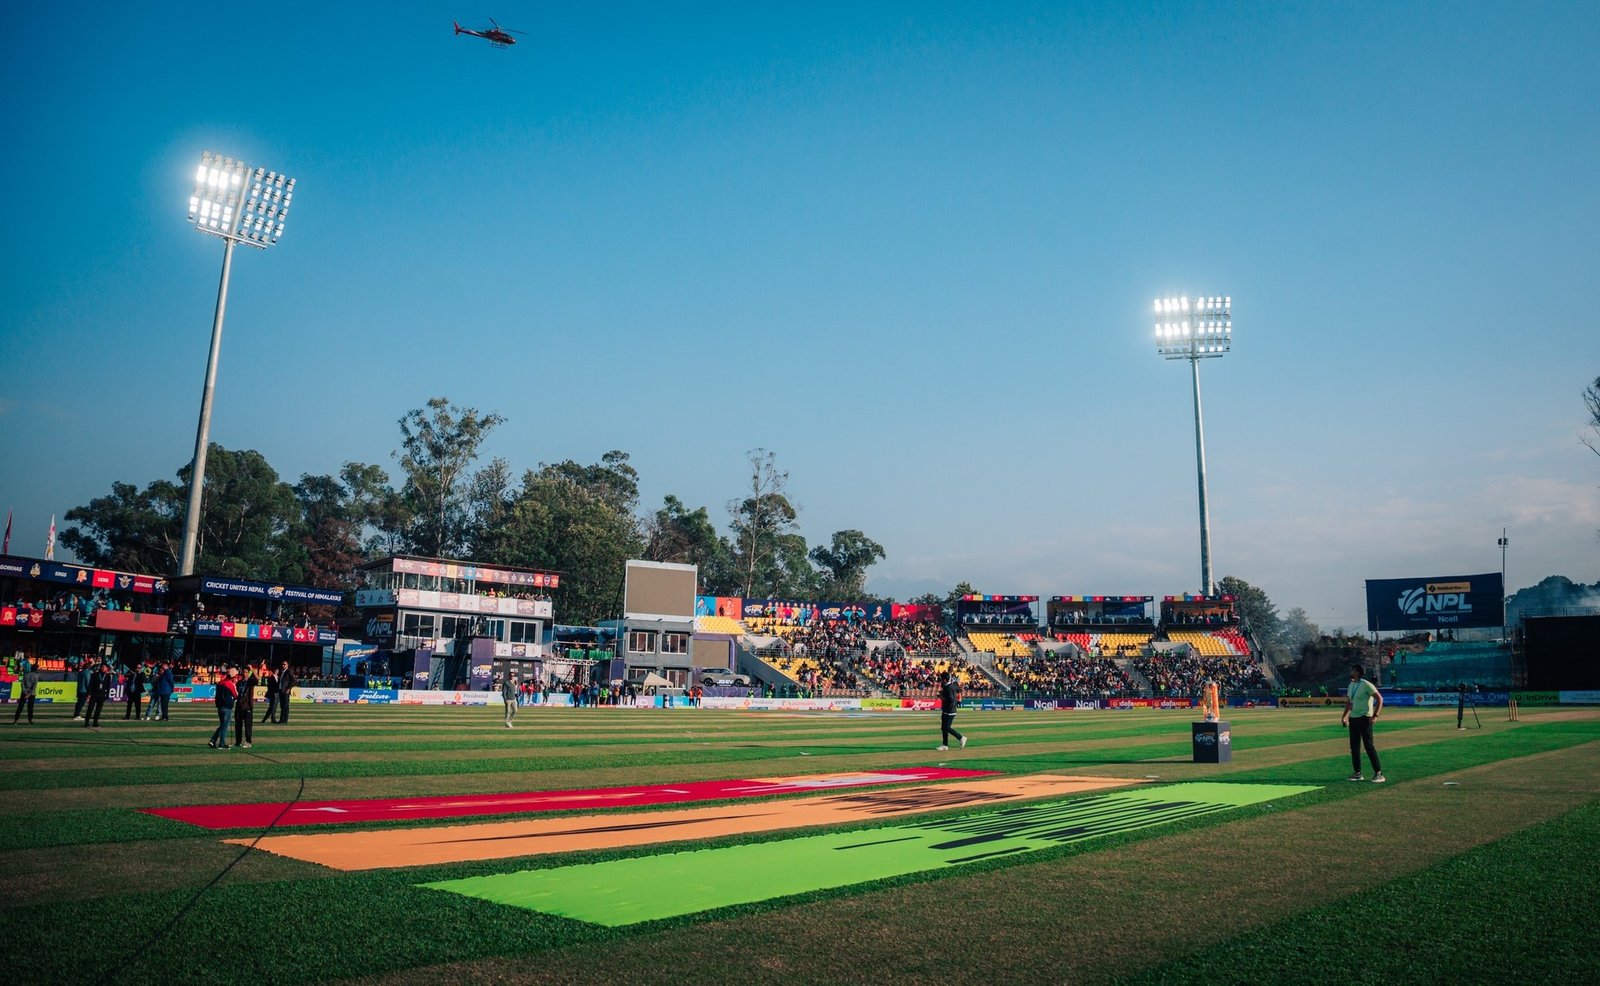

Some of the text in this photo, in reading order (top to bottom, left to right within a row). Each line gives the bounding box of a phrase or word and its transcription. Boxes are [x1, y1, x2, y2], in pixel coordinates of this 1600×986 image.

[206, 581, 265, 594] CRICKET UNITES NEPAL
[285, 589, 307, 598] FESTIVAL
[314, 593, 342, 601] HIMALAYAS
[1425, 593, 1473, 611] NPL
[1438, 615, 1458, 623] Ncell
[376, 623, 393, 634] NPL
[109, 684, 124, 698] ell
[1033, 700, 1058, 708] Ncell
[1076, 699, 1100, 708] Ncell
